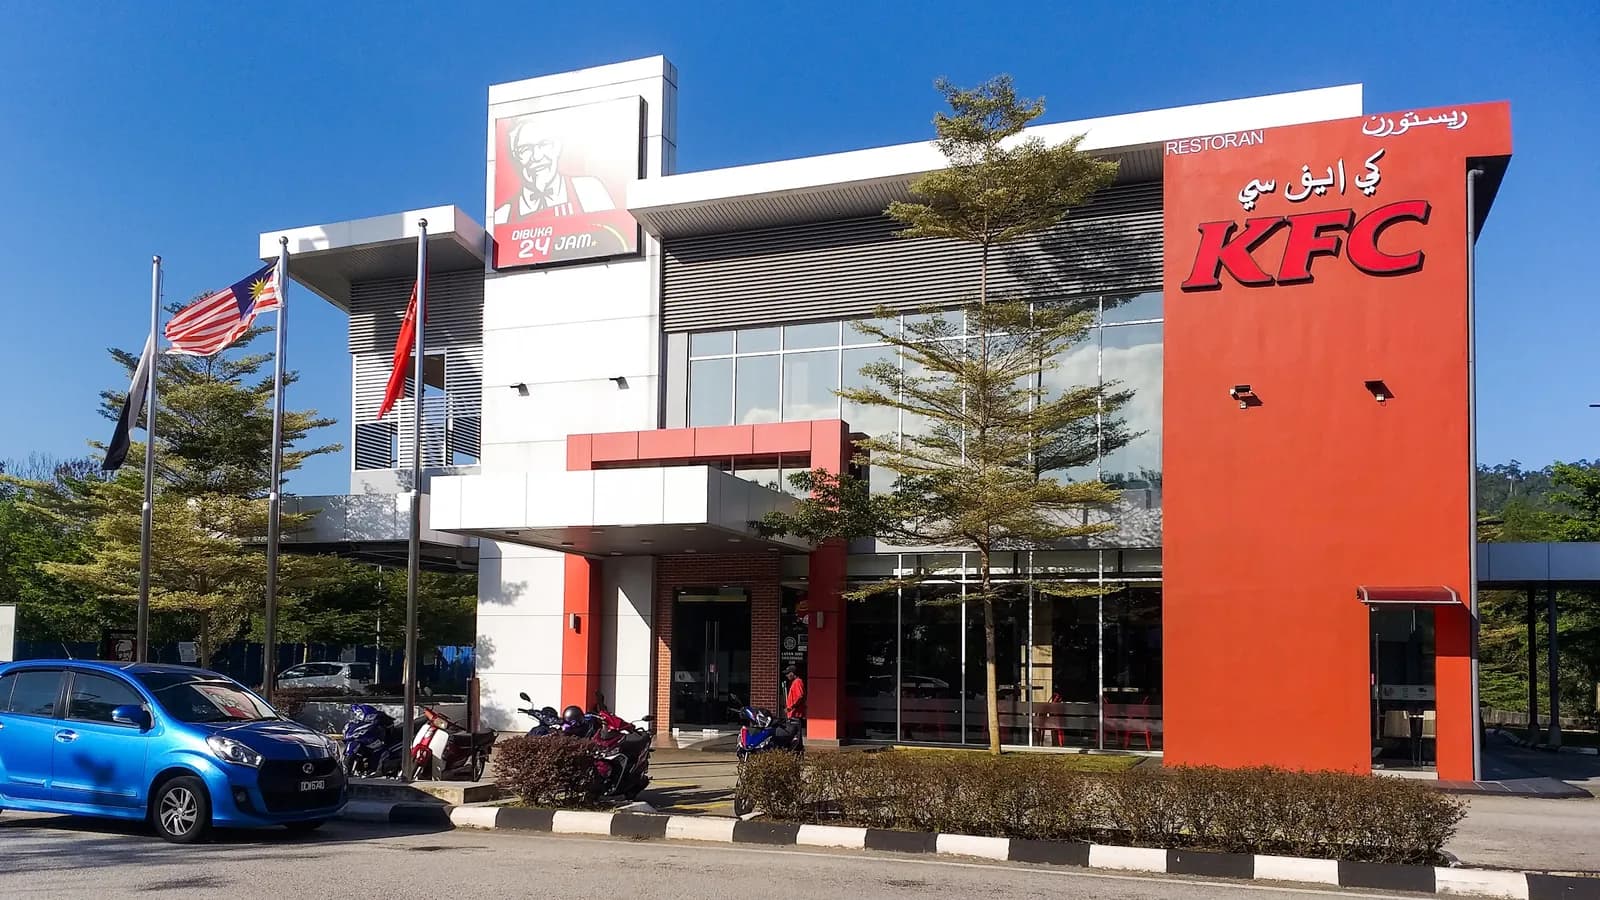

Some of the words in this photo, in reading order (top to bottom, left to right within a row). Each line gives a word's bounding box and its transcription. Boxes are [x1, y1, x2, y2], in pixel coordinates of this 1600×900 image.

[1362, 110, 1468, 137] ريستورن
[1165, 130, 1264, 156] RESTORAN
[1354, 148, 1386, 195] كي
[1238, 177, 1277, 211] سي
[511, 226, 553, 241] DIBUKA
[1181, 200, 1433, 292] KFC
[518, 237, 551, 259] 24
